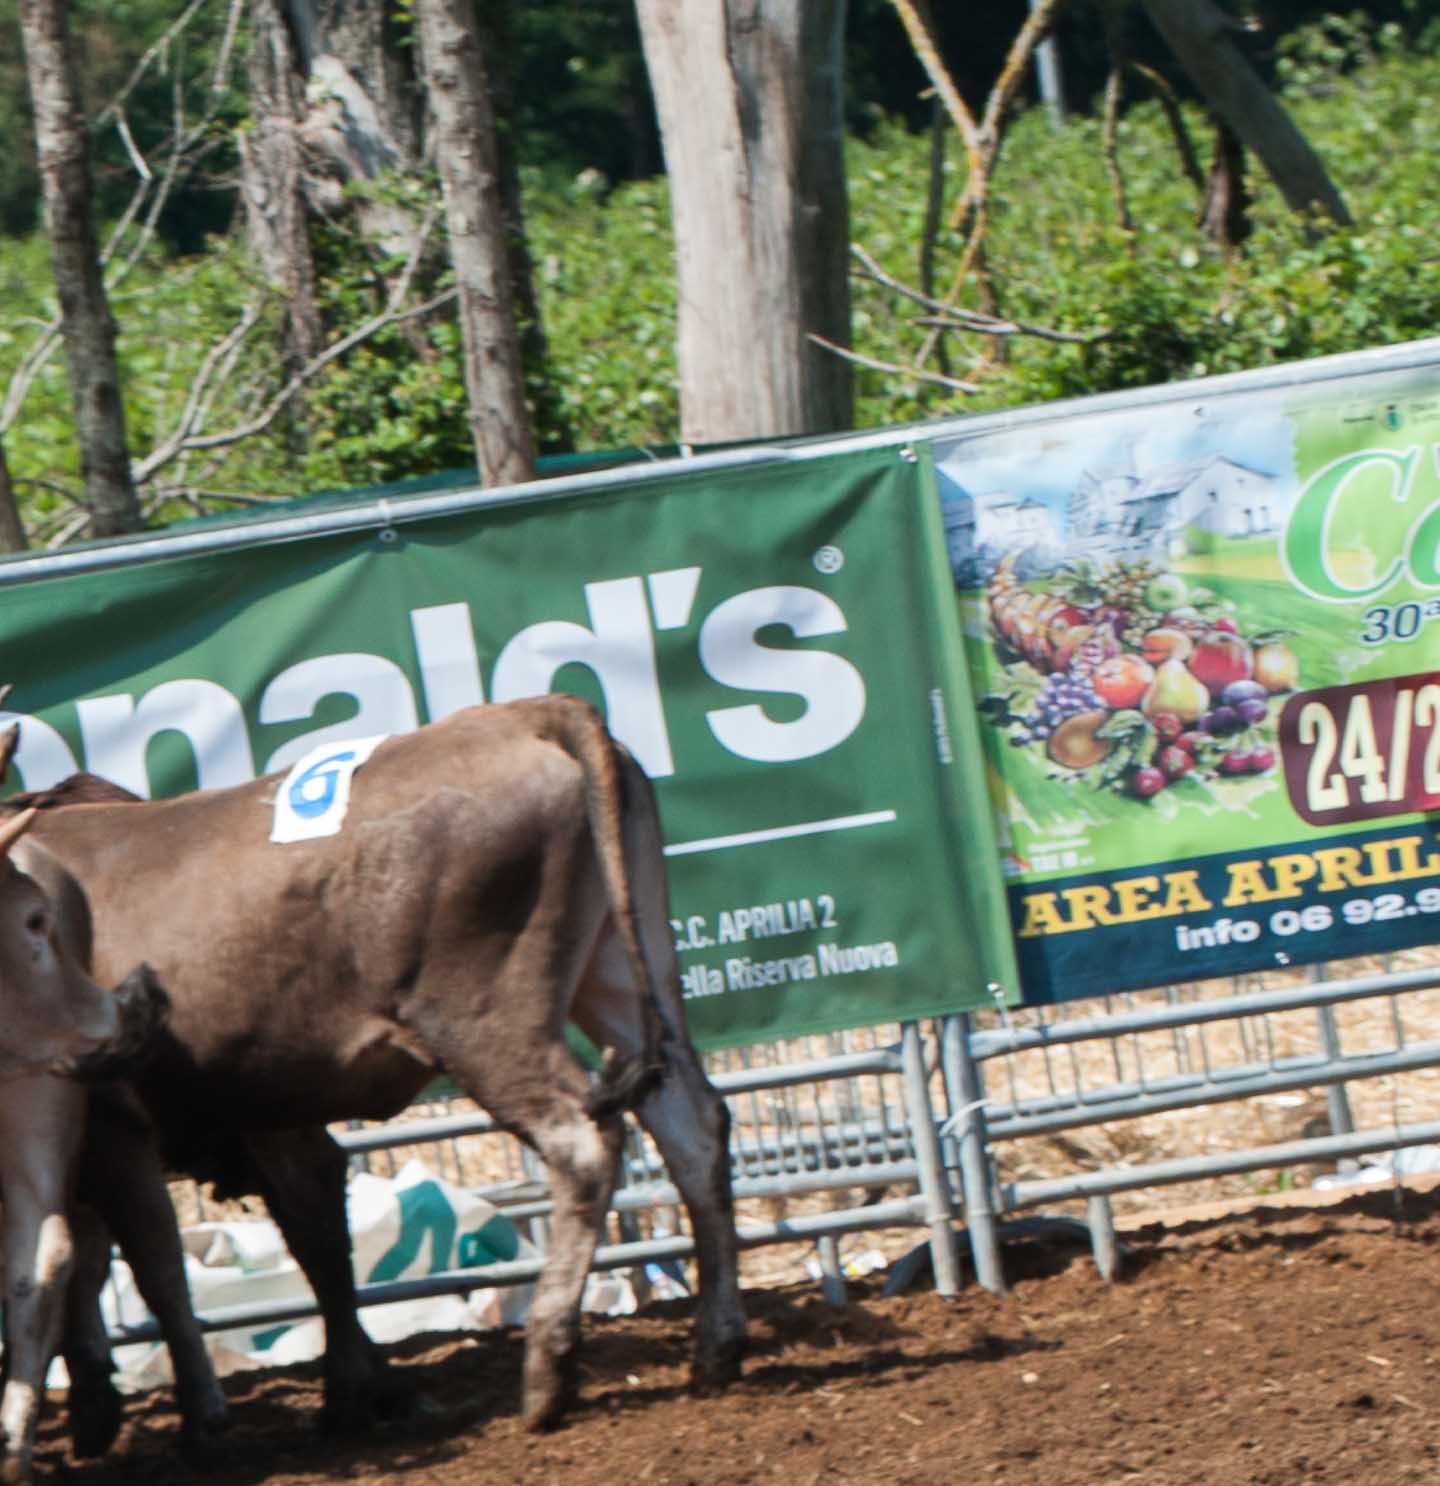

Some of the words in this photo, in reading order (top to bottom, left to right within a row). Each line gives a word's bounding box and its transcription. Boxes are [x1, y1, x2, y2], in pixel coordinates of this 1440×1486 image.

[288, 750, 357, 820] 6
[1018, 868, 1213, 939] AREA
[1221, 835, 1440, 908] APRIL
[717, 898, 818, 945] APRILIA
[817, 894, 839, 929] 2
[1175, 917, 1261, 952] info
[1269, 904, 1334, 937] 06
[724, 953, 818, 992] Riserva
[816, 940, 899, 977] Nuova
